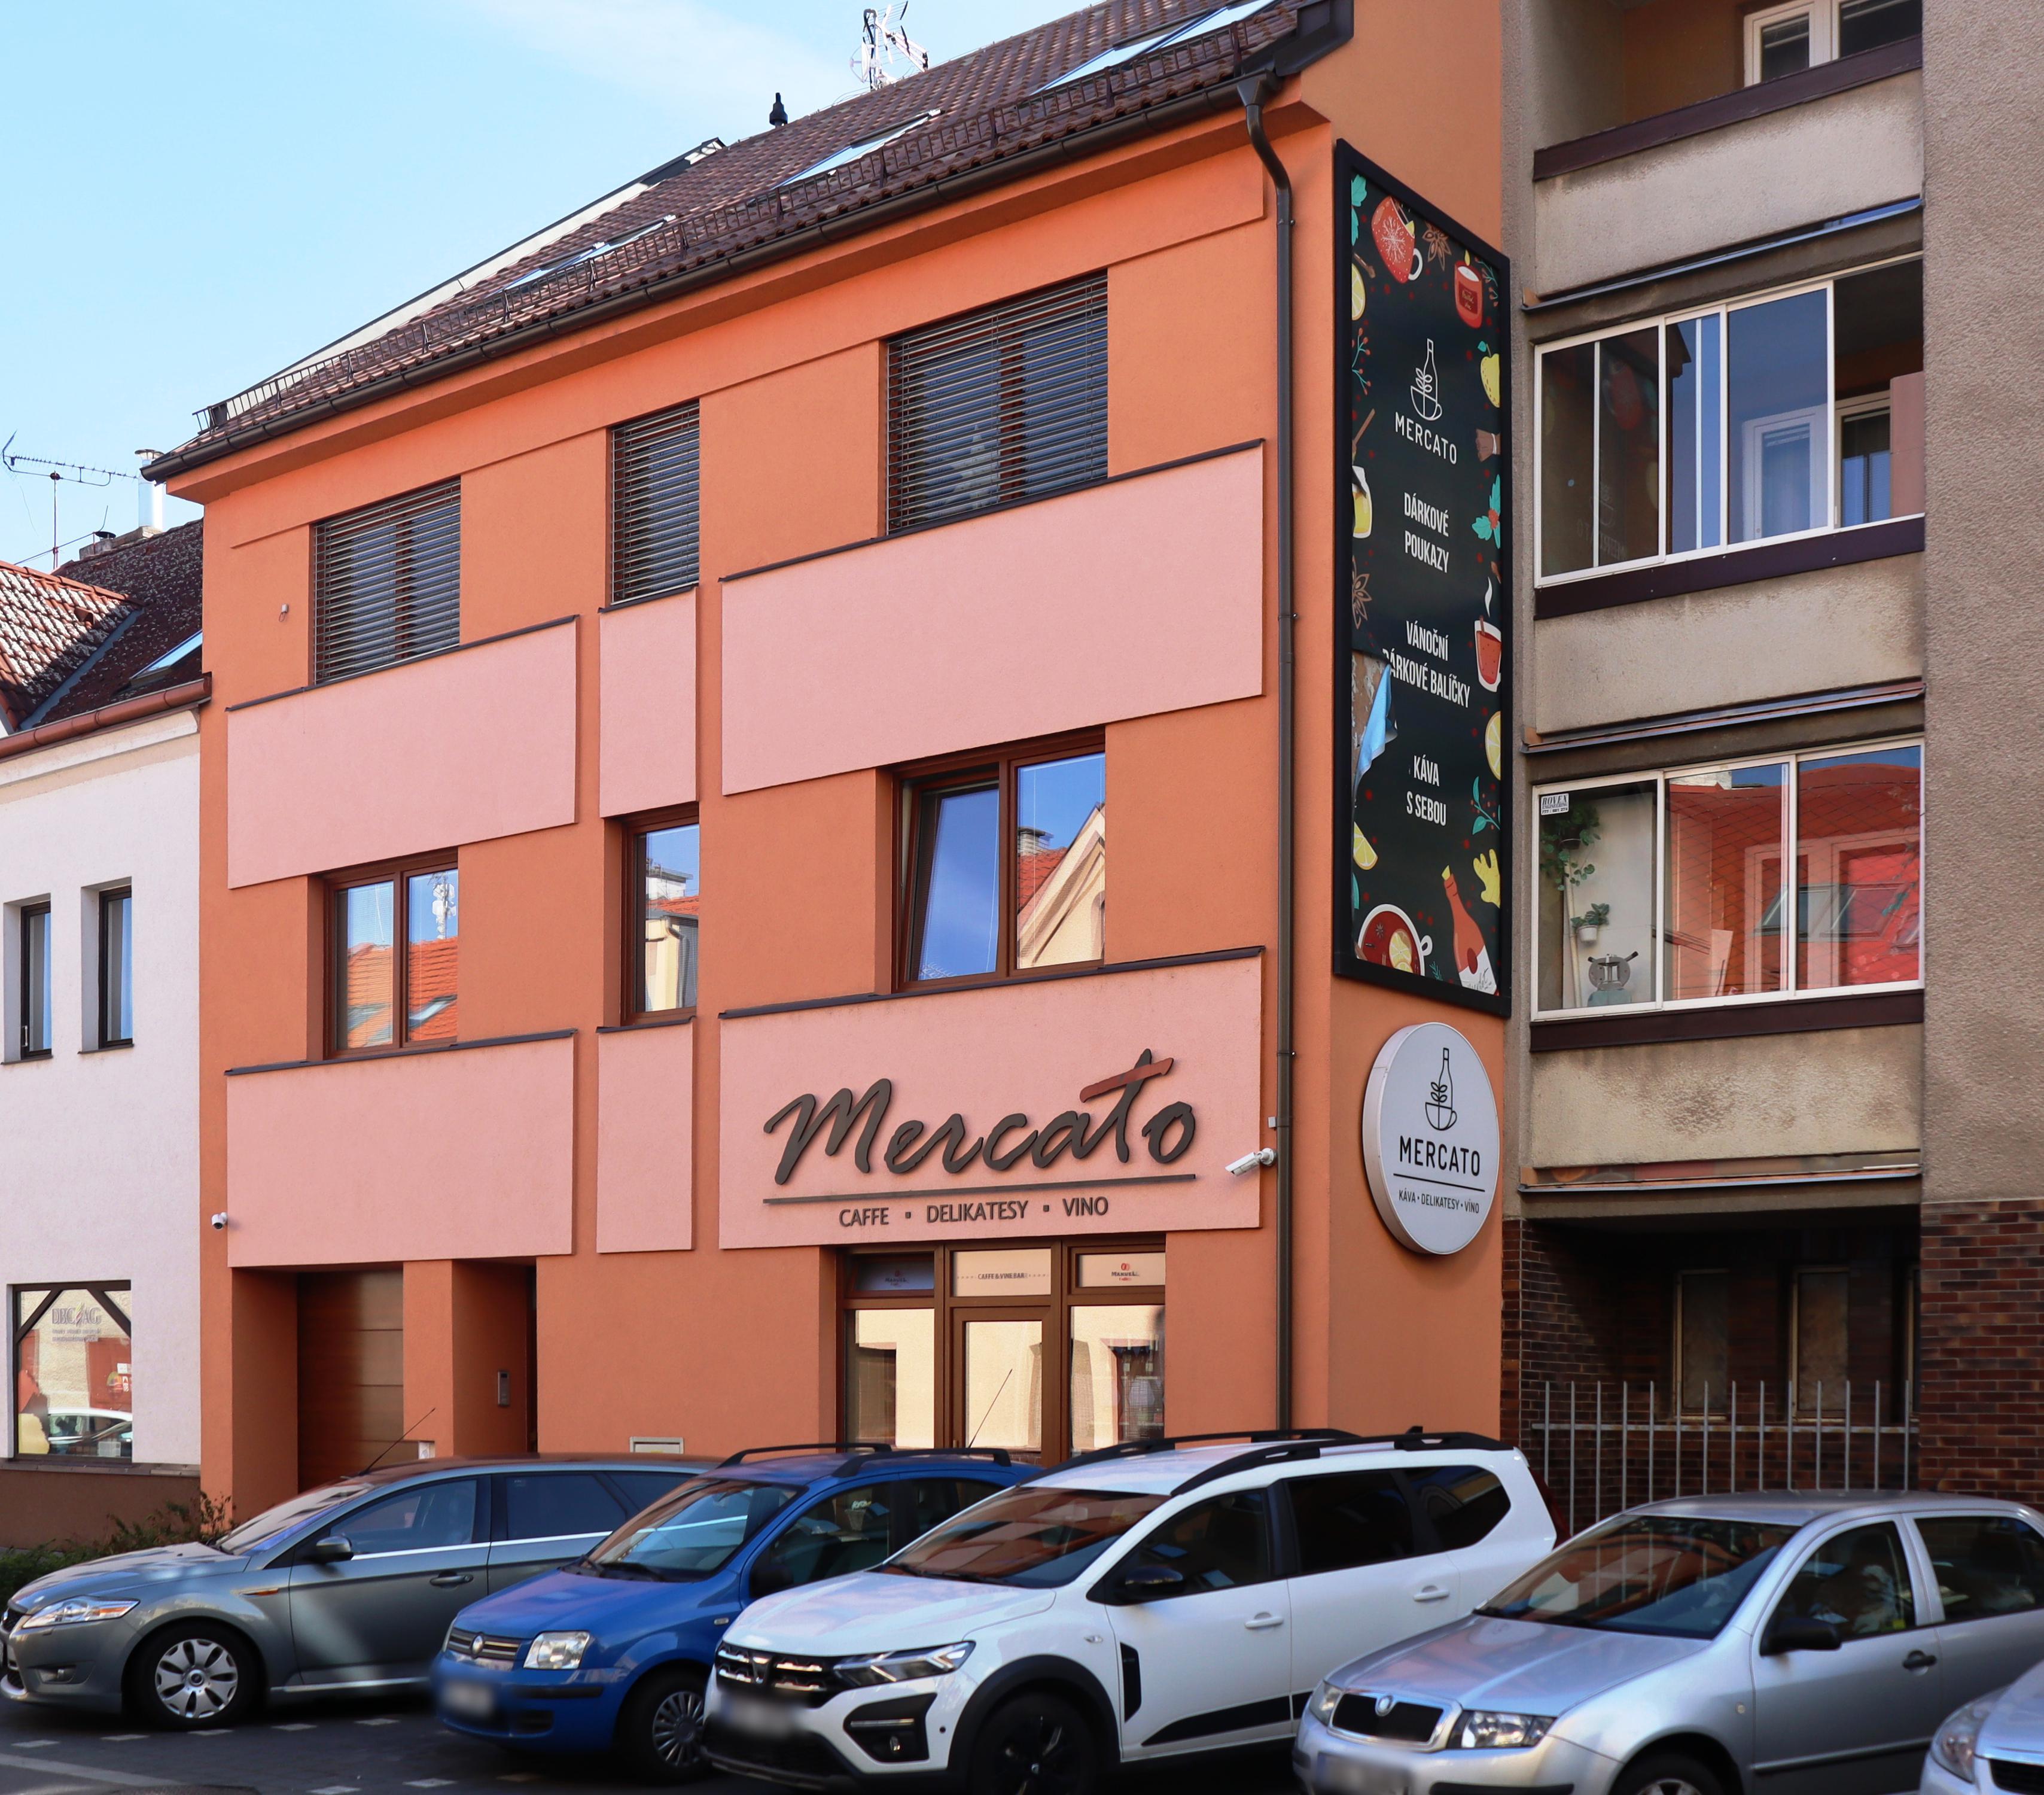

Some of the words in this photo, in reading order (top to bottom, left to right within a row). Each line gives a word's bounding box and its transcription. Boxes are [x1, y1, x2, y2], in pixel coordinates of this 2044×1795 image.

[1395, 412, 1457, 465] MERCATO
[1404, 492, 1449, 537] DÁRKOVÉ
[1405, 530, 1449, 573] POUKAZY
[1406, 620, 1449, 661] VÁNOČNÍ
[1430, 669, 1470, 708] BALÍČKY
[1414, 754, 1440, 787] KÁVA
[1406, 790, 1413, 814] S
[1415, 793, 1446, 826] SEBOU
[763, 1048, 1196, 1185] Mercato
[1400, 1135, 1481, 1176] MERCATO
[839, 1206, 890, 1227] CAFFE
[926, 1200, 1029, 1223] DELIKATESY
[1062, 1196, 1108, 1216] VINO
[1399, 1188, 1416, 1203] KÁVA
[1421, 1193, 1460, 1210] DELIKATESY
[1464, 1198, 1480, 1214] VÍNO
